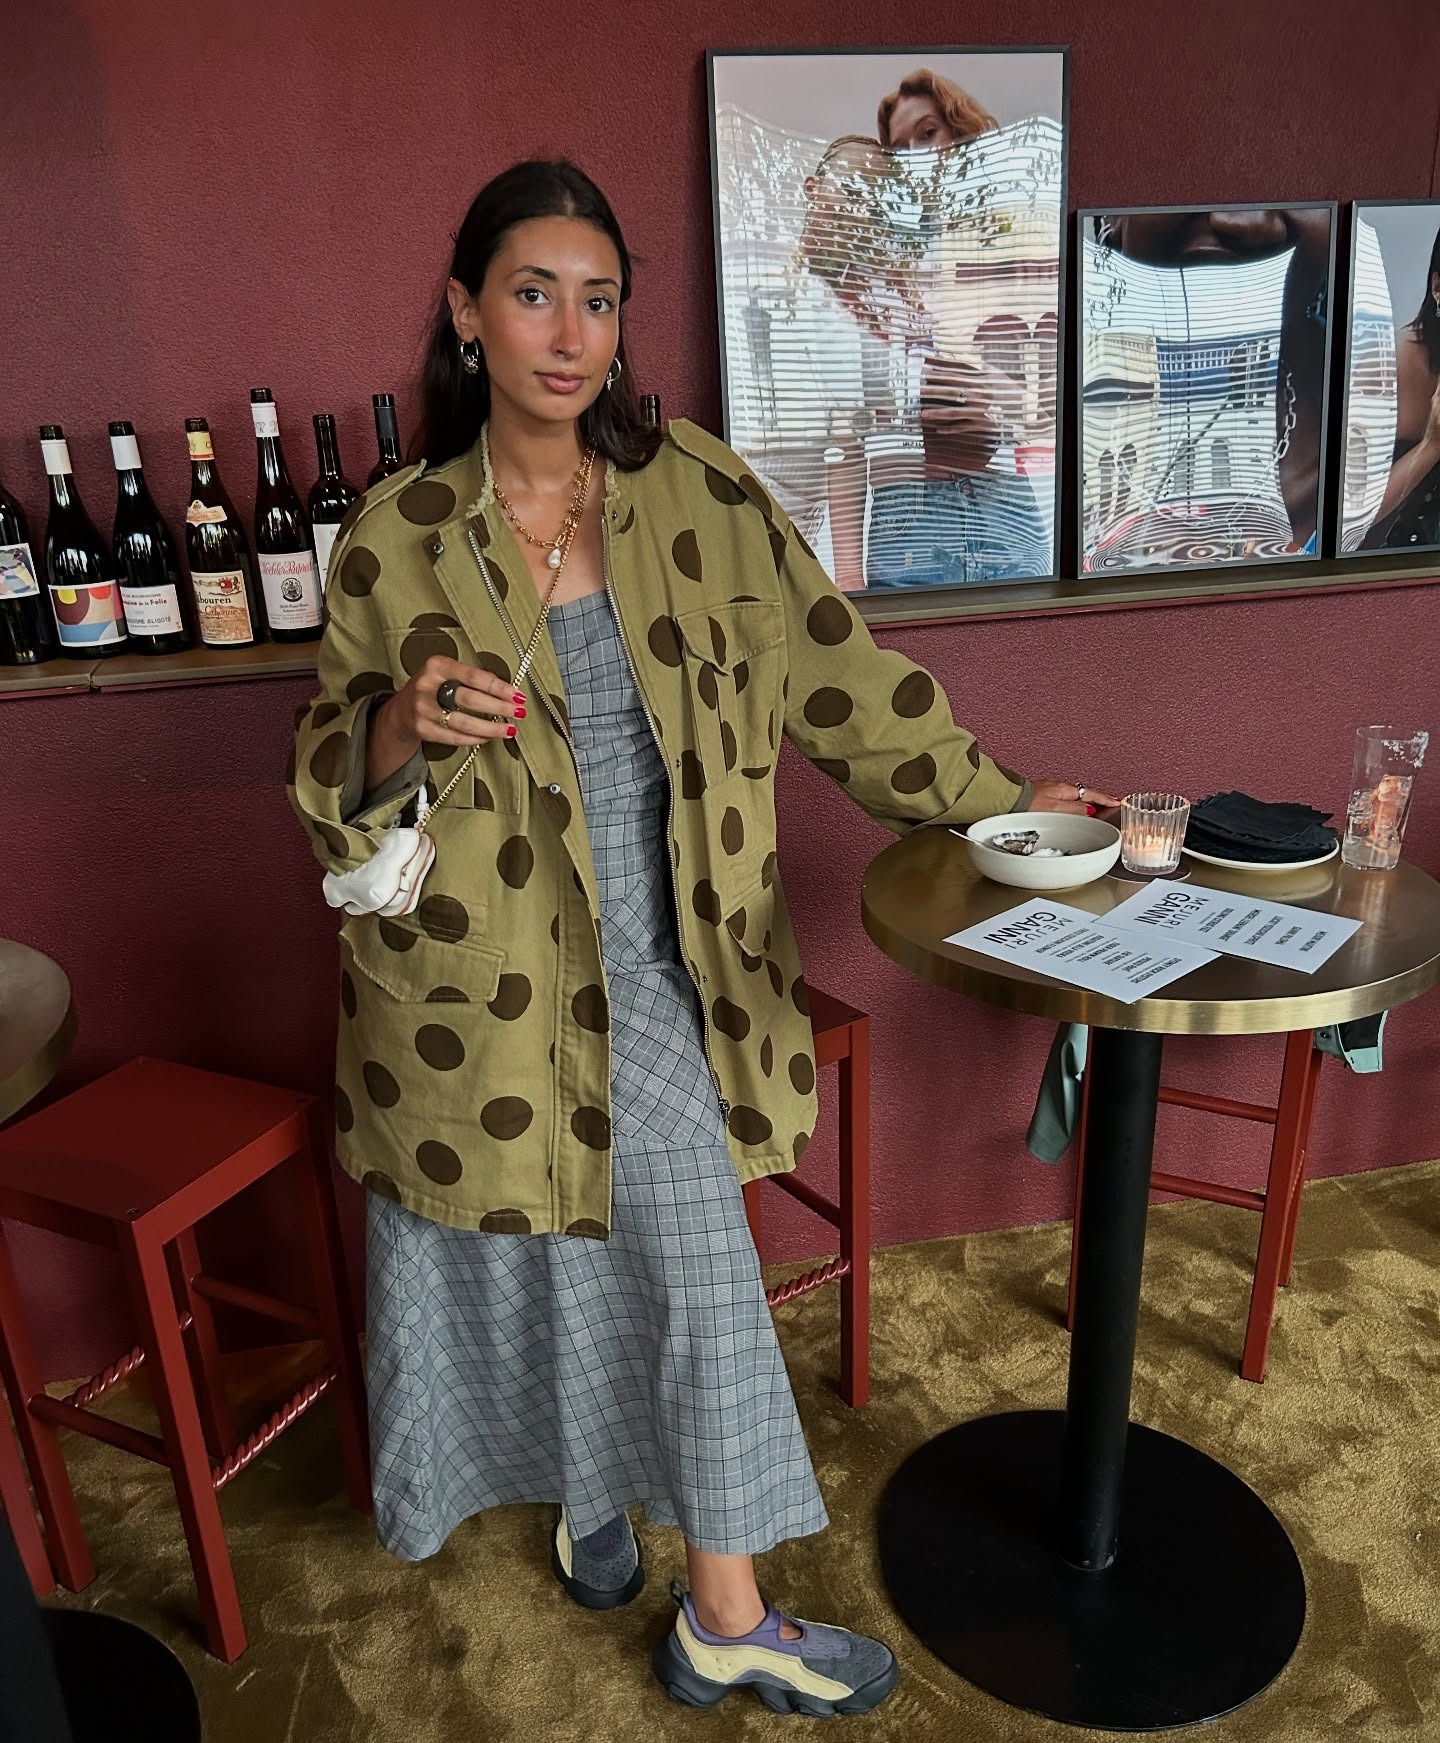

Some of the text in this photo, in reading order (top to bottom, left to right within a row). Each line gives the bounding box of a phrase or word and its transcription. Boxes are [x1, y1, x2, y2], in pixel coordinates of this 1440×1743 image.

[1135, 893, 1190, 925] GANNI
[1160, 897, 1209, 929] MEJURI
[984, 912, 1056, 943] GANNI
[1005, 918, 1073, 949] MEJURI
